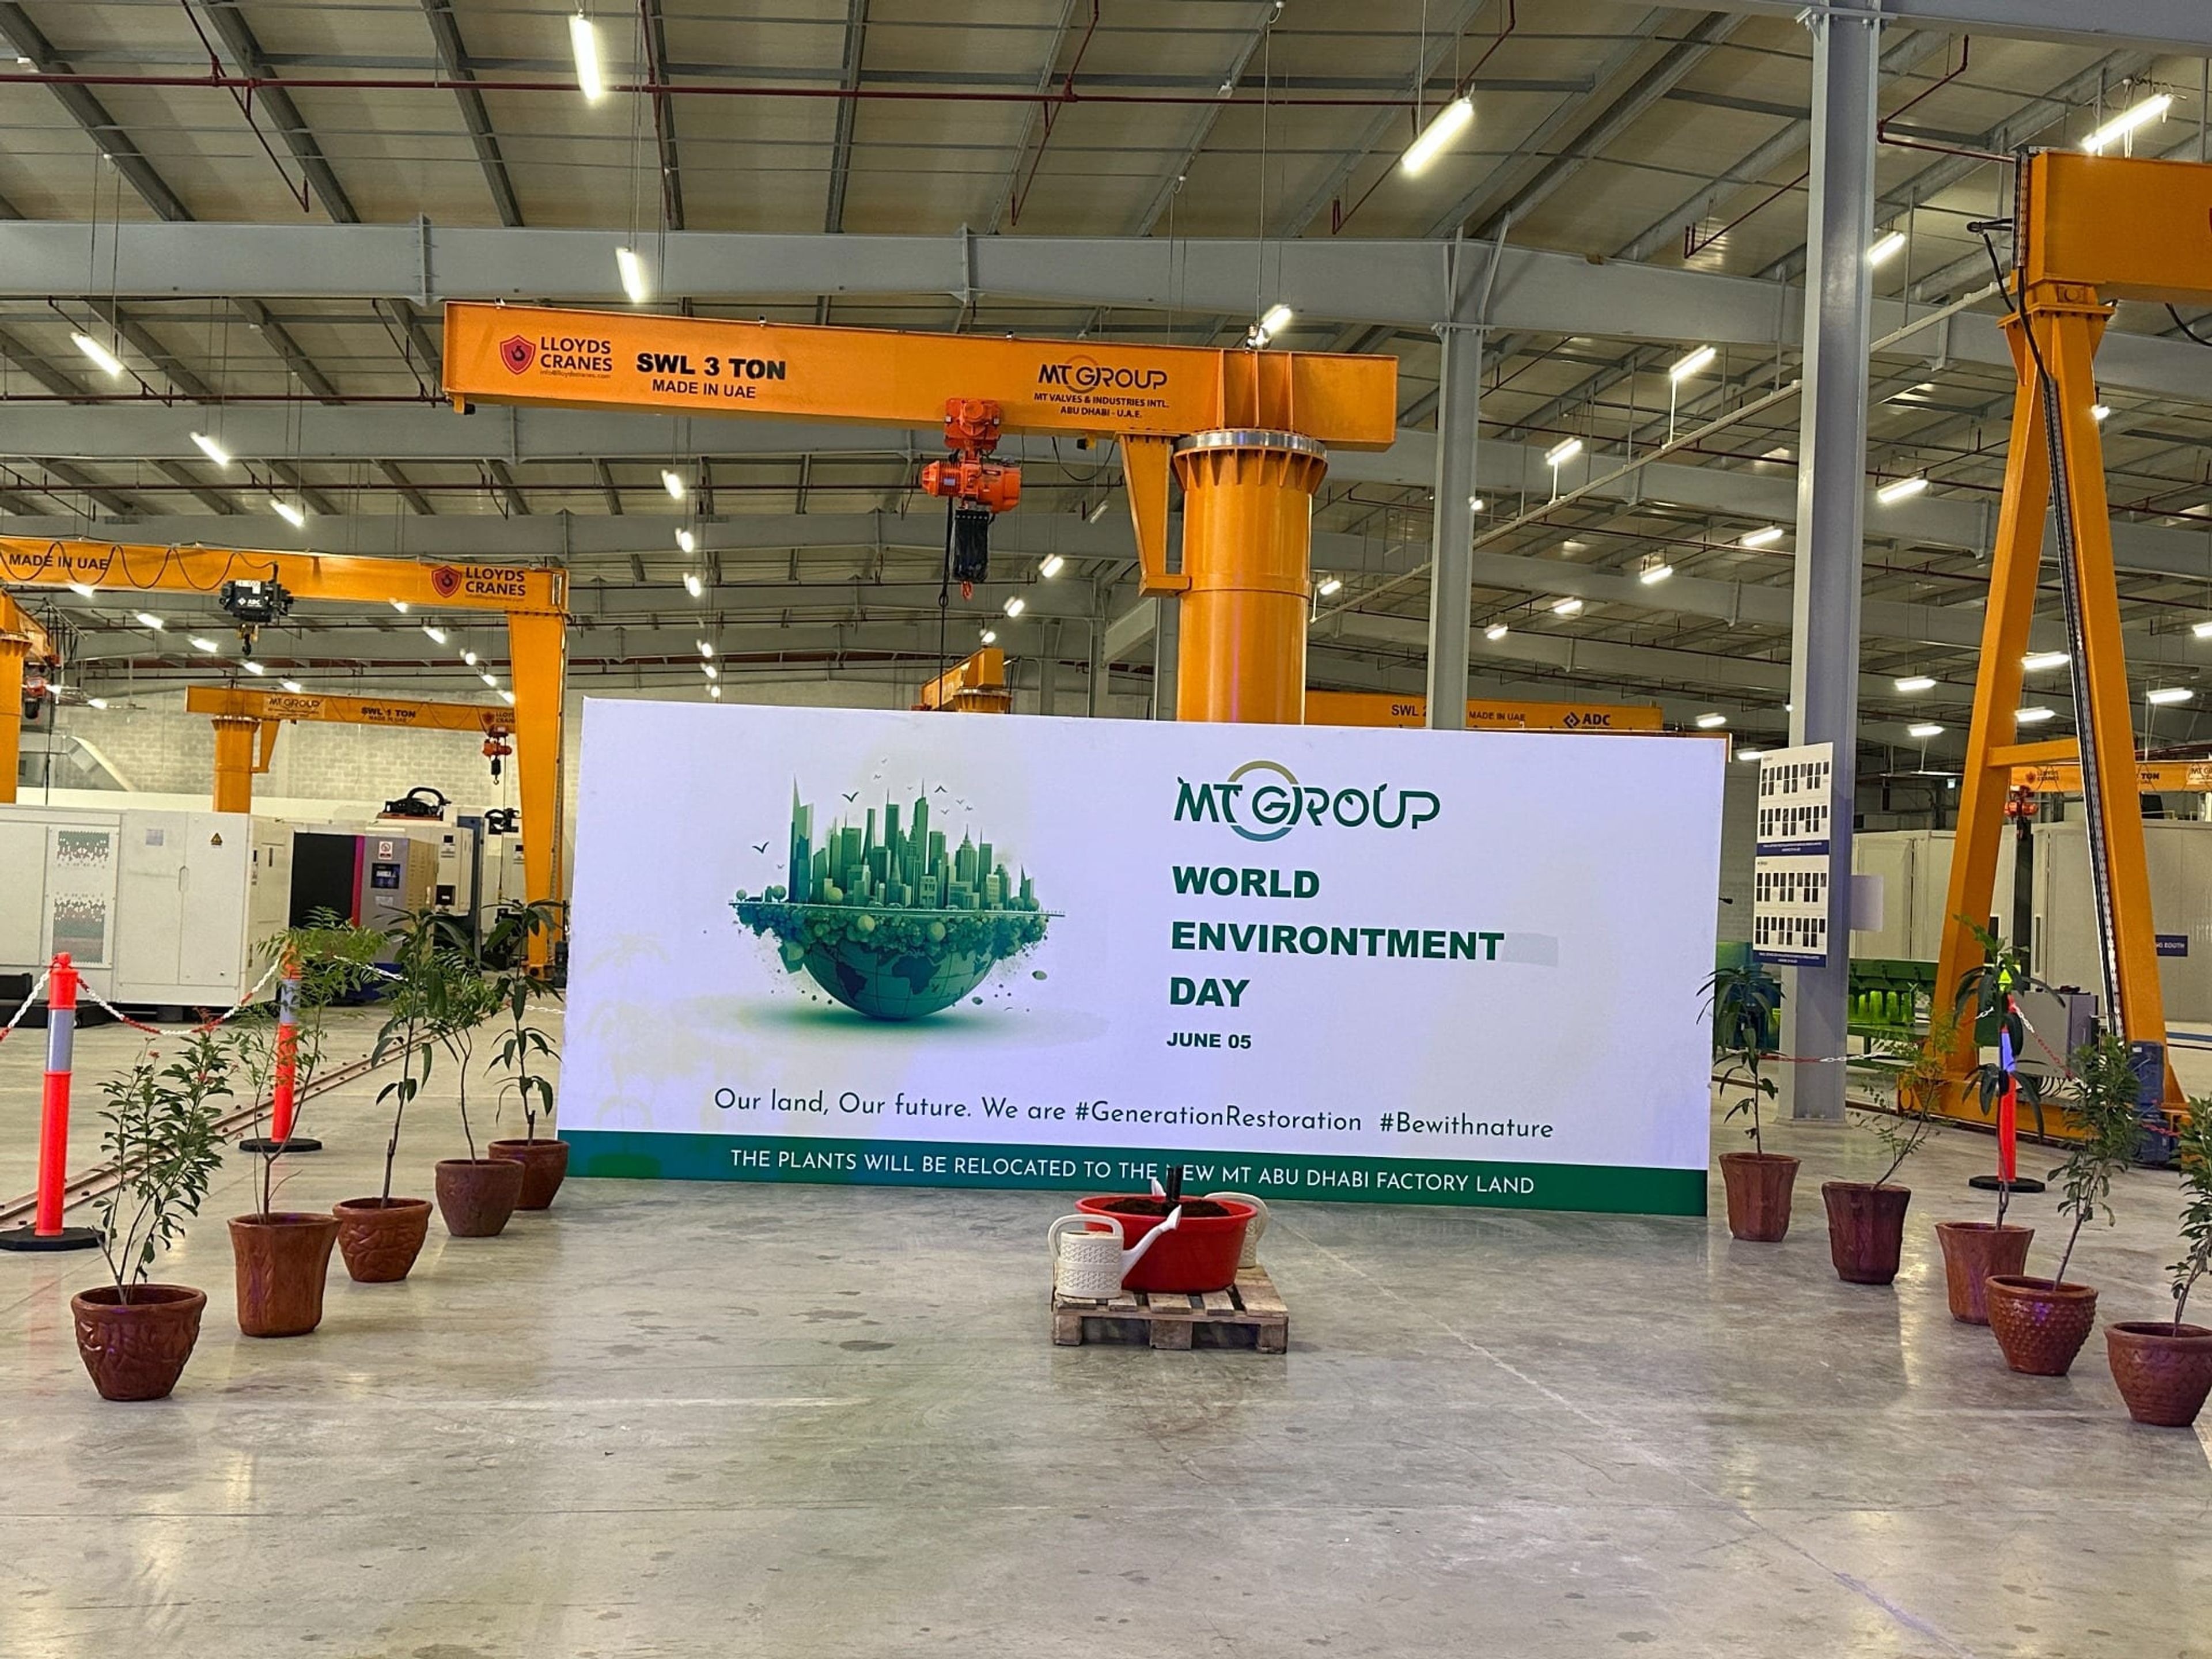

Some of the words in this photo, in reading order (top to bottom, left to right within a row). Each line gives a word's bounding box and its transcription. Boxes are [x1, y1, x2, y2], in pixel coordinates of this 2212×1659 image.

[541, 337, 611, 354] LLOYDS
[540, 354, 612, 372] CRANES
[637, 353, 695, 374] SWL
[704, 357, 719, 376] 3
[728, 358, 786, 380] TON
[652, 379, 699, 394] MADE
[703, 383, 718, 396] IN
[724, 385, 756, 399] UAE
[1034, 392, 1048, 401] MT
[1049, 393, 1082, 403] VALVES
[1093, 396, 1145, 407] INDUSTRIES
[1147, 399, 1169, 408] INTL.
[1060, 406, 1079, 415] ABU
[1081, 407, 1109, 416] DHABI
[9, 554, 53, 567] MADE
[58, 556, 72, 568] IN
[77, 558, 109, 570] UAE
[465, 567, 525, 582] LLOYDS
[465, 581, 526, 596] CRANES
[361, 707, 382, 715] SWL
[395, 709, 415, 718] TON
[1391, 704, 1418, 716] SWL
[1469, 711, 1494, 719] MADE
[1497, 712, 1505, 720] IN
[1582, 713, 1611, 726] ADC
[1172, 866, 1320, 898] WORLD
[1172, 922, 1504, 961] ENVIRONTMENT
[1170, 977, 1250, 1007] DAY
[1166, 1032, 1221, 1048] JUNE
[1228, 1034, 1252, 1049] 05
[715, 1088, 761, 1109] Our
[771, 1088, 828, 1115] land,
[839, 1092, 885, 1113] Our
[895, 1093, 971, 1117] future.
[982, 1097, 1018, 1118] We
[1028, 1105, 1066, 1120] are
[1075, 1100, 1361, 1131] #GenerationRestoration
[1380, 1111, 1554, 1138] #Bewithnature
[731, 1150, 770, 1167] THE
[778, 1152, 857, 1170] PLANTS
[864, 1154, 914, 1172] WILL
[922, 1156, 946, 1173] BE
[954, 1157, 1076, 1177] RELOCATED
[1084, 1161, 1111, 1178] TO
[1119, 1162, 1157, 1180] THE
[1166, 1162, 1215, 1181] EW
[1222, 1166, 1251, 1183] MT
[1258, 1167, 1298, 1185] ABU
[1306, 1170, 1369, 1188] DHABI
[1376, 1172, 1469, 1191] FACTORY
[1476, 1176, 1535, 1194] LAND
